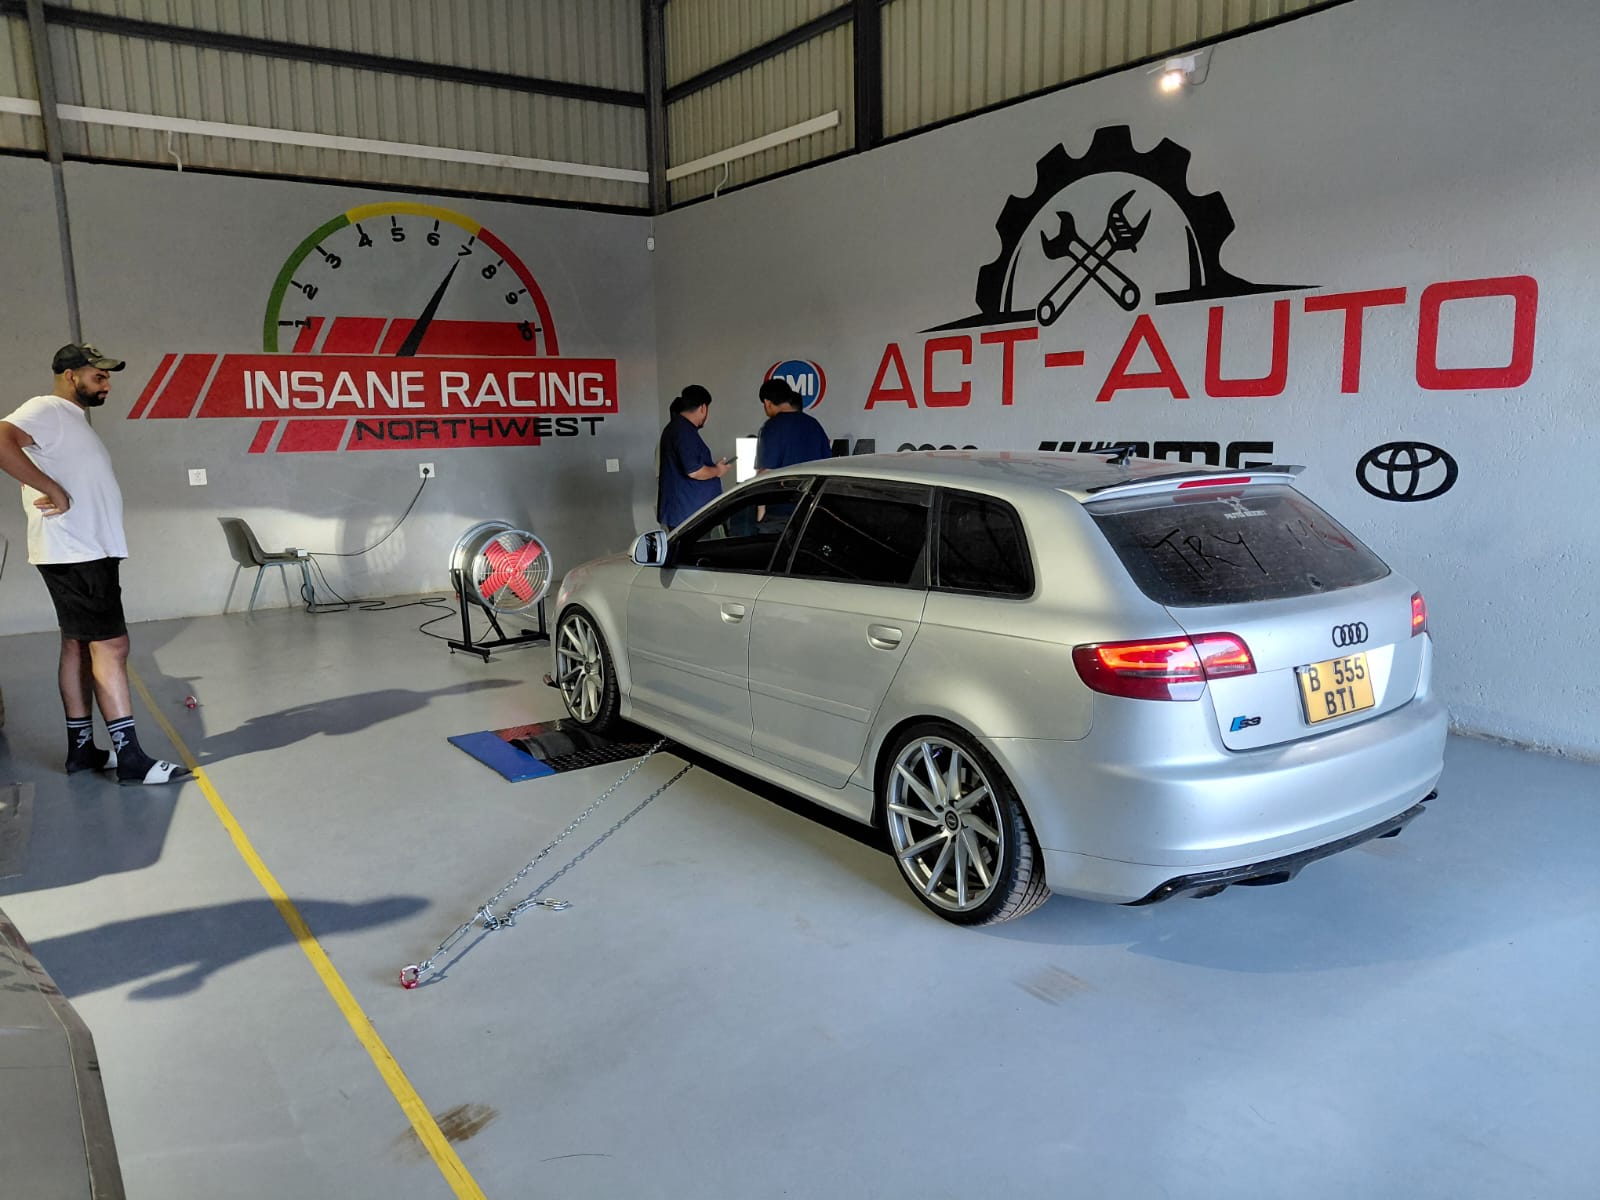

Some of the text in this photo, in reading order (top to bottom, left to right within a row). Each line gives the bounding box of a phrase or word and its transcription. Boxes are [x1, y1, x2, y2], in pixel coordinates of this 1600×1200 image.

[358, 232, 373, 248] 4
[391, 227, 406, 242] 5
[426, 232, 441, 247] 6
[457, 244, 473, 257] 7
[325, 253, 342, 270] 3
[481, 264, 497, 280] 8
[302, 283, 319, 300] 2
[505, 292, 519, 305] 9
[294, 318, 312, 330] 1
[516, 320, 533, 342] 10
[863, 274, 1539, 411] ACT-AUTO
[243, 371, 612, 410] INSANE RACING.
[354, 416, 605, 442] NORTHWEST
[1151, 527, 1268, 582] TRY
[1308, 657, 1365, 692] B 555
[1324, 686, 1356, 716] BTI
